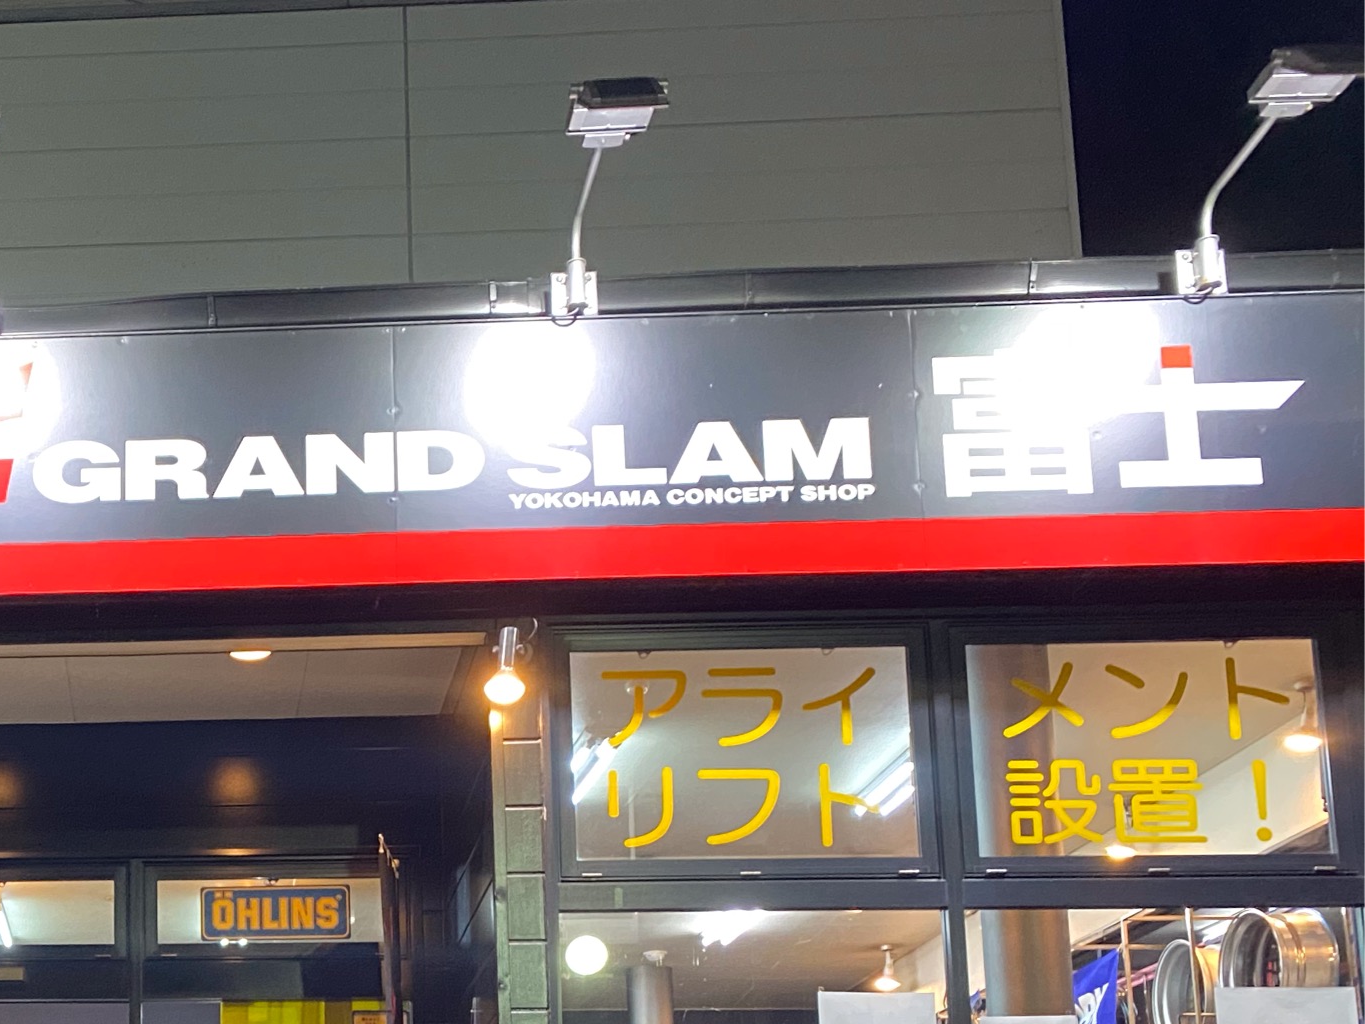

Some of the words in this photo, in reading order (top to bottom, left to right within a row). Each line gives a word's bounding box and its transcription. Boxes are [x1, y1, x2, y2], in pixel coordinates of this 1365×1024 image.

[33, 431, 485, 503] GRAND
[507, 417, 872, 489] SLAM
[508, 489, 661, 510] YOKOHAMA
[666, 486, 794, 506] CONCEPT
[800, 483, 876, 503] SHOP
[211, 889, 339, 932] ÖHLINS
